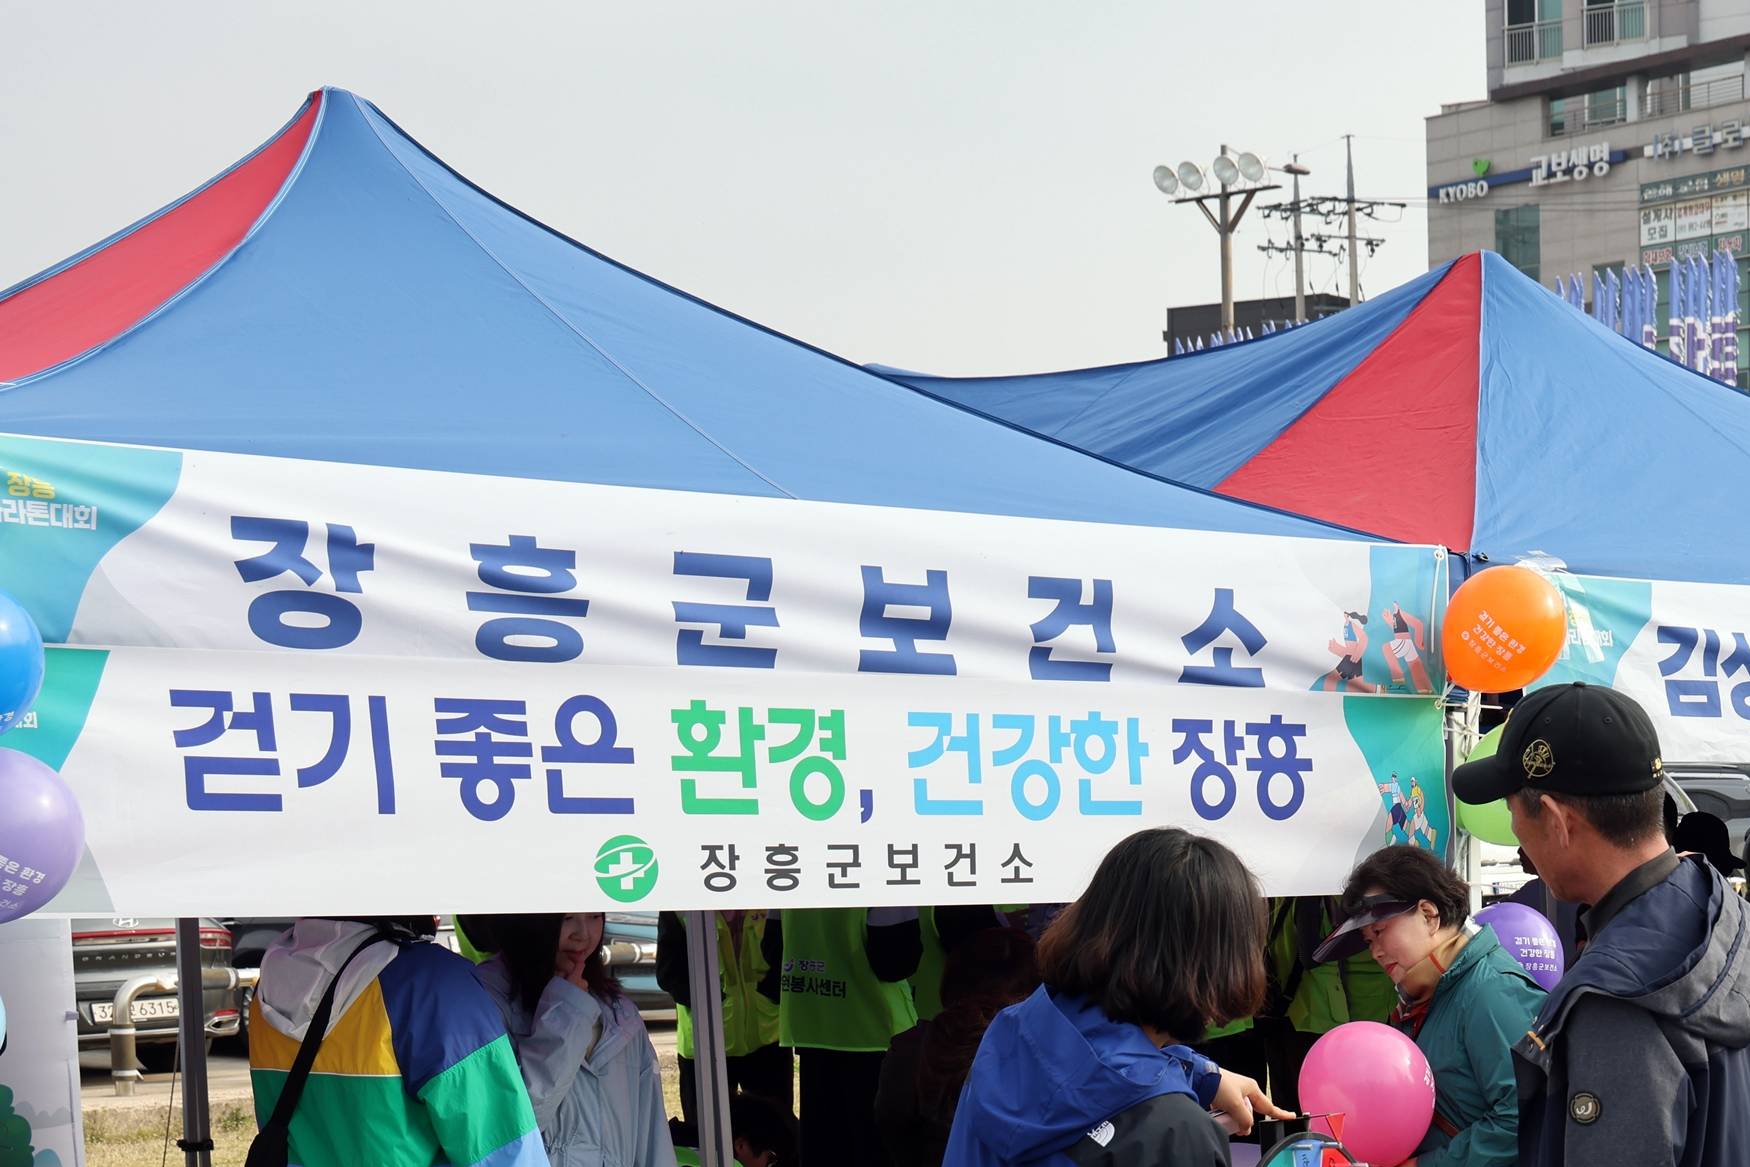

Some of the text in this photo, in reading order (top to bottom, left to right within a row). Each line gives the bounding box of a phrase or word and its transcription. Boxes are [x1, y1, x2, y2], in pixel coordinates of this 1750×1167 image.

[1528, 141, 1611, 188] 교보생명
[1438, 179, 1490, 204] KYOBO
[168, 688, 1314, 825] 걷기 좋은 환경, 건강한 장흥
[139, 1001, 175, 1017] 6315
